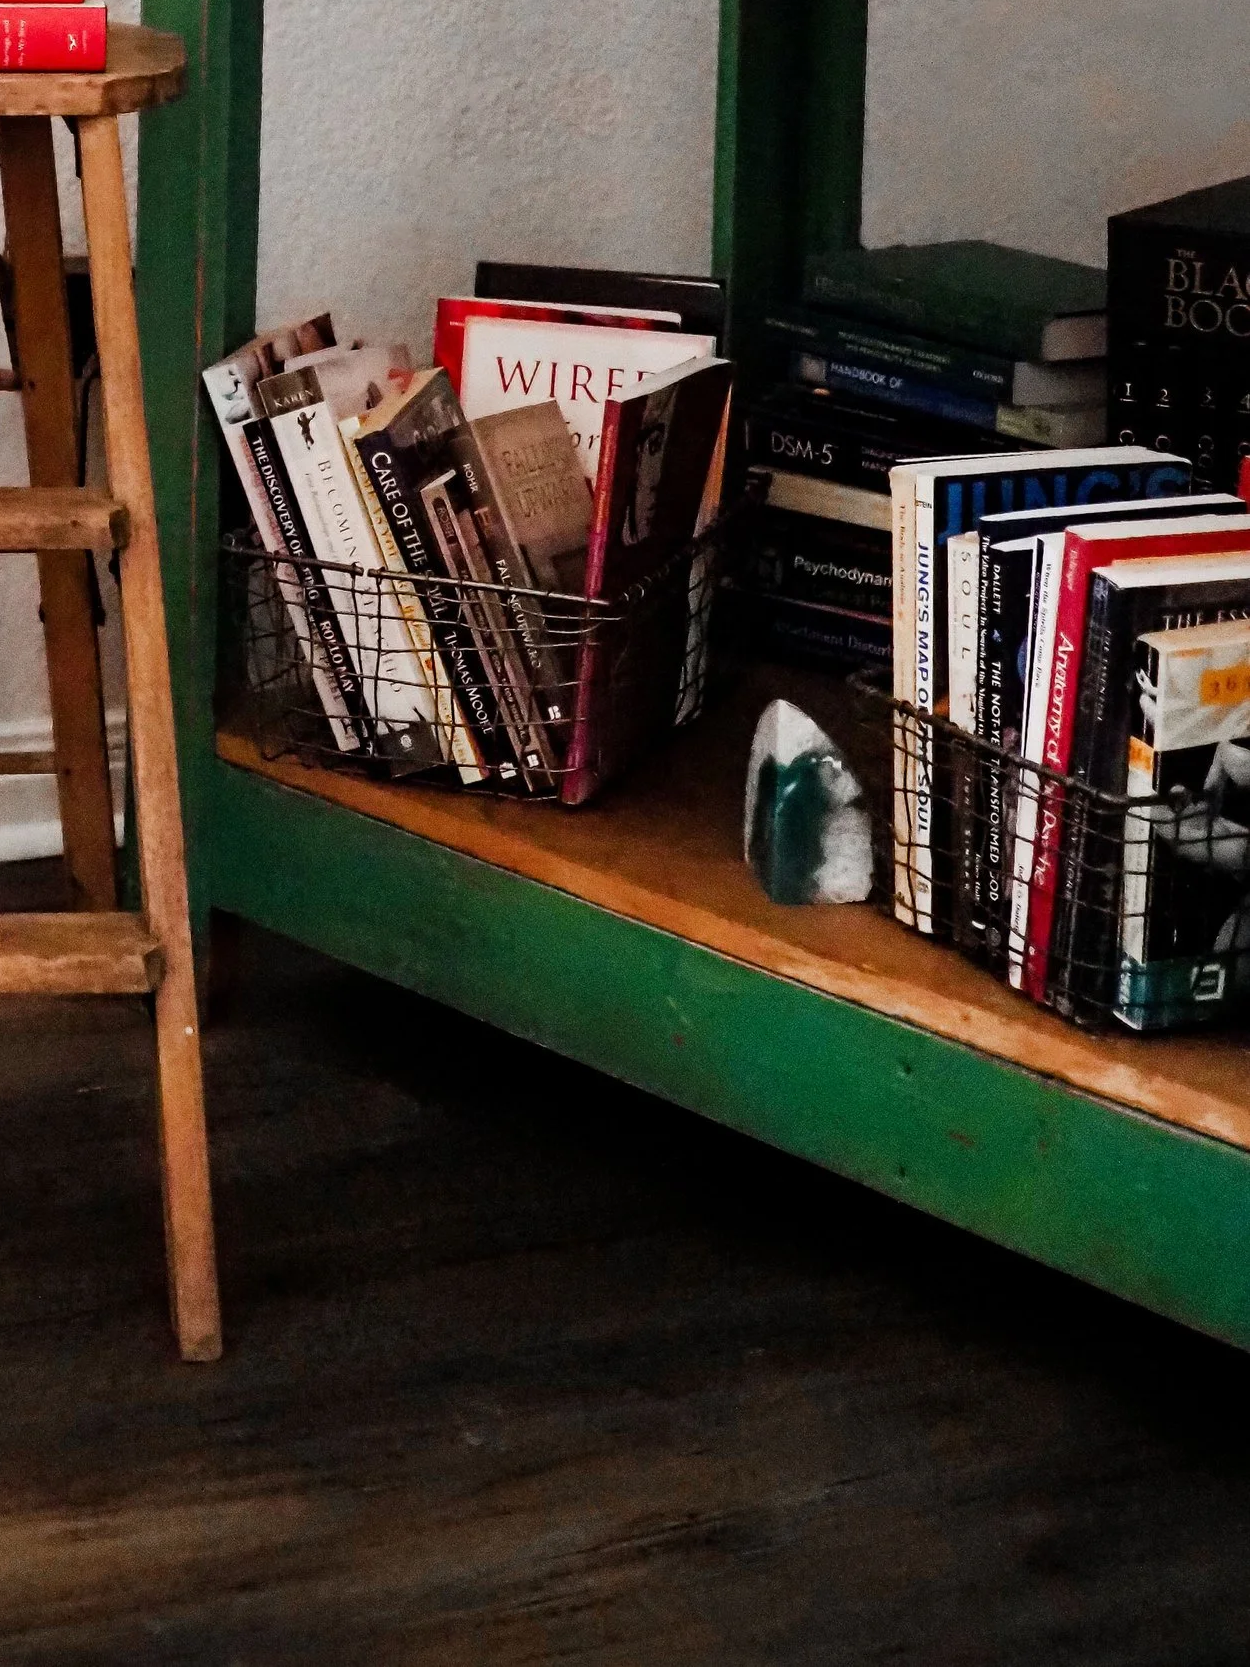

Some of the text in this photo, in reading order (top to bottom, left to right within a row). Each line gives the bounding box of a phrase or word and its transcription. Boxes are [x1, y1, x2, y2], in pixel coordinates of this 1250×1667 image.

[1174, 247, 1197, 259] THE
[496, 356, 655, 403] WIRE
[830, 361, 903, 389] HANDBOOK OF
[273, 388, 314, 408] KAREN
[1160, 387, 1170, 402] 2
[251, 437, 270, 467] THE
[771, 430, 836, 465] DSM-5
[462, 463, 479, 494] ROHR
[260, 464, 298, 539] DISCOVERY
[317, 459, 361, 565] BECOMIN
[289, 539, 305, 558] OF
[981, 534, 991, 552] The
[370, 451, 396, 501] CARE
[391, 500, 413, 533] OF
[402, 529, 429, 570] THE
[443, 631, 472, 691] THOMAS
[991, 564, 1001, 614] DALLETT
[961, 551, 972, 660] SOUL
[978, 616, 987, 625] In
[975, 660, 985, 669] of
[975, 671, 984, 685] the
[991, 660, 1002, 688] THE
[917, 542, 930, 832] JUNG'S MAP SOUL
[1047, 632, 1075, 736] Anatomy
[990, 693, 1001, 750] NOT-YE
[1047, 739, 1061, 765] of
